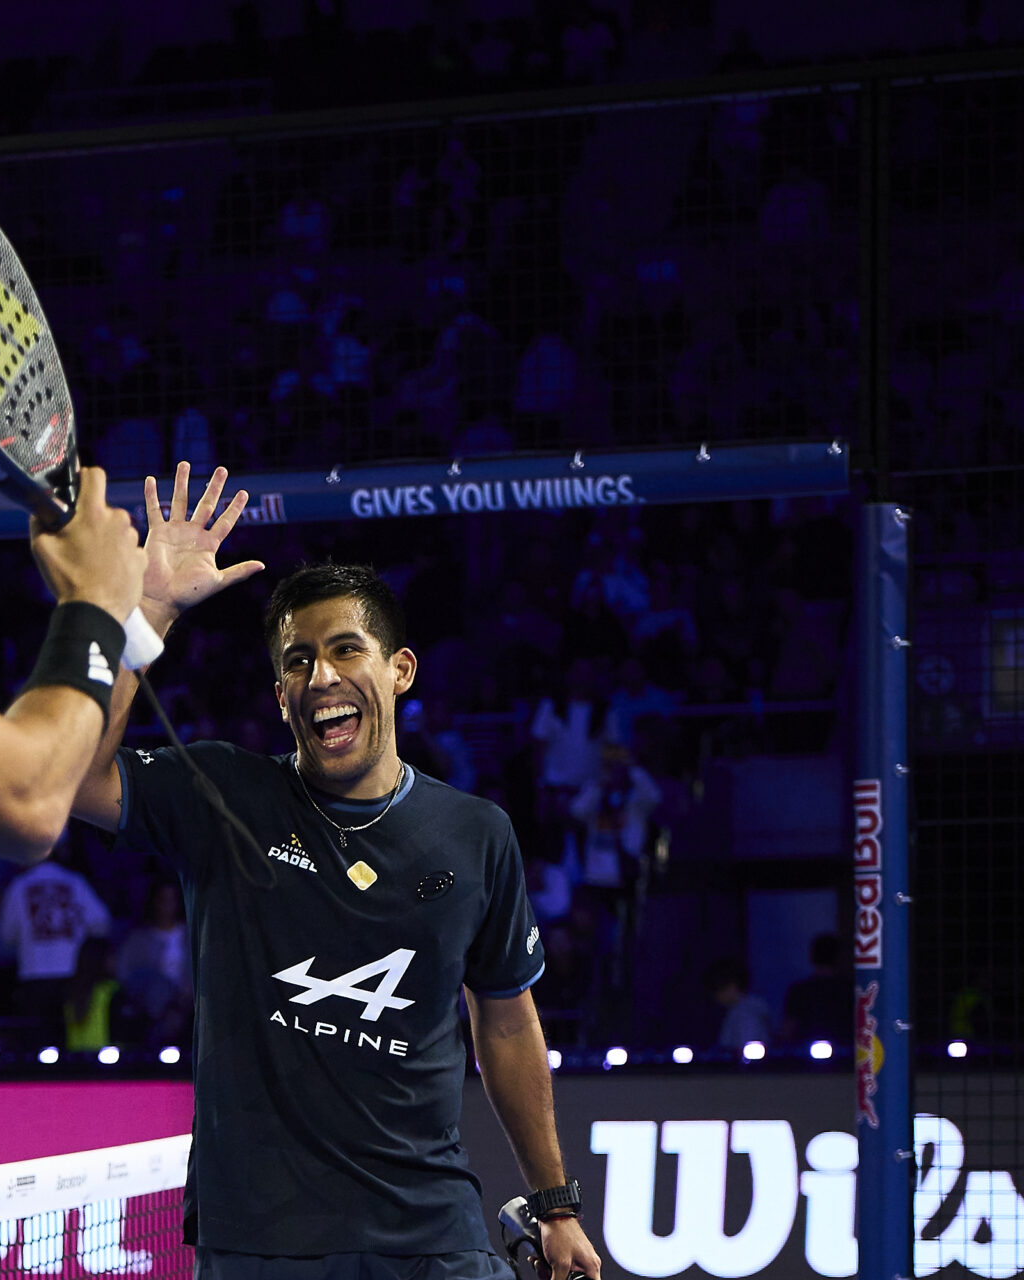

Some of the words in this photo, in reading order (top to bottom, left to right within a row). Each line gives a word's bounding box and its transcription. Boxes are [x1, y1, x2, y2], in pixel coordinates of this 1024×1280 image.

[350, 484, 436, 519] GIVES
[441, 481, 506, 512] YOU
[854, 778, 884, 872] Bull
[268, 846, 318, 873] PADEL
[269, 1009, 409, 1057] ALPINE
